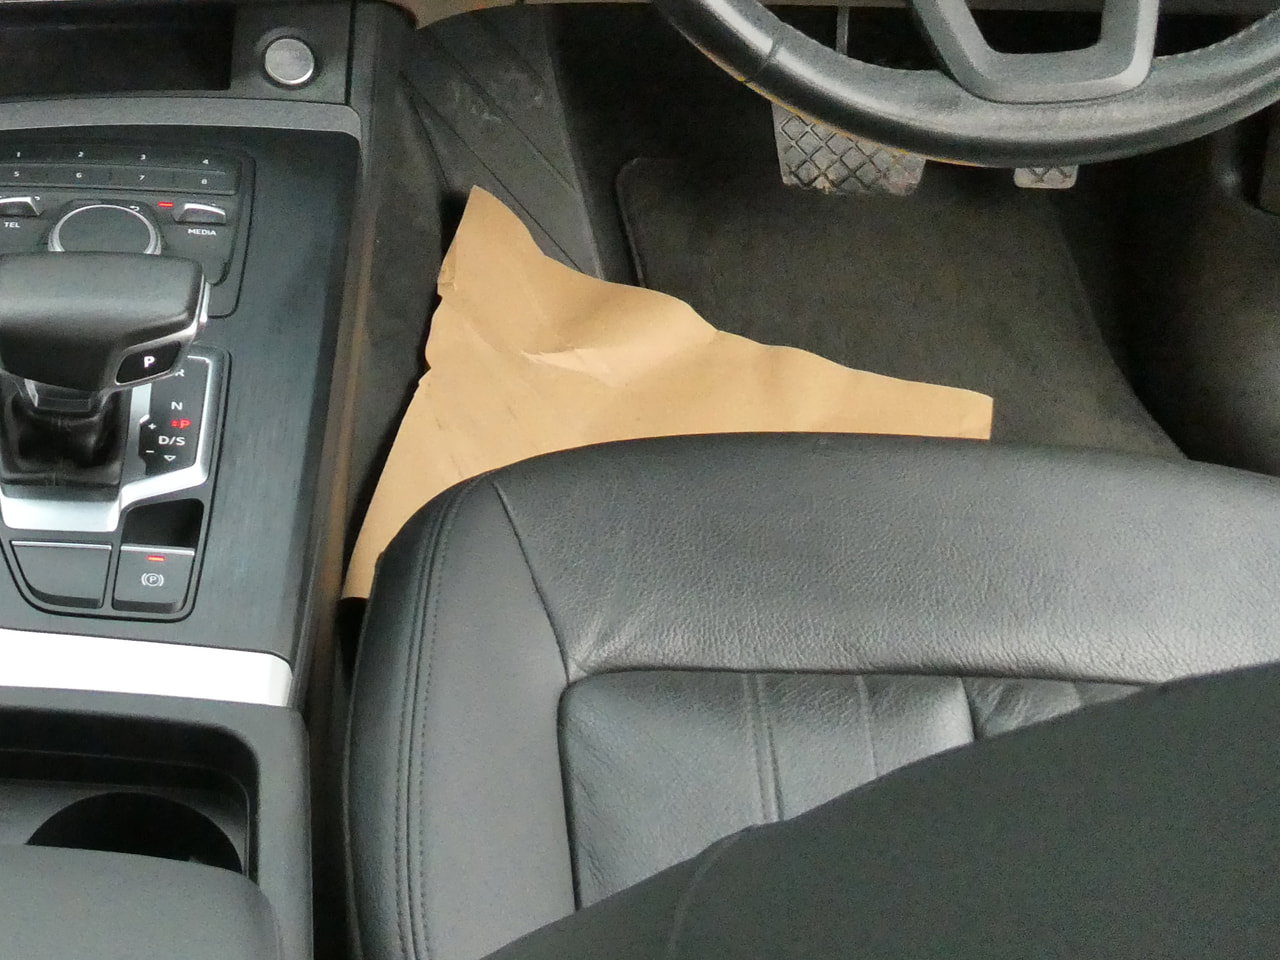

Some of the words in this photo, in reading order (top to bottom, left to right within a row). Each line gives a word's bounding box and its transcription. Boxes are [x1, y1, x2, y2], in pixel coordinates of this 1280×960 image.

[187, 228, 217, 236] MEDIA
[143, 356, 155, 368] P
[171, 401, 183, 410] N
[158, 435, 186, 445] D/S
